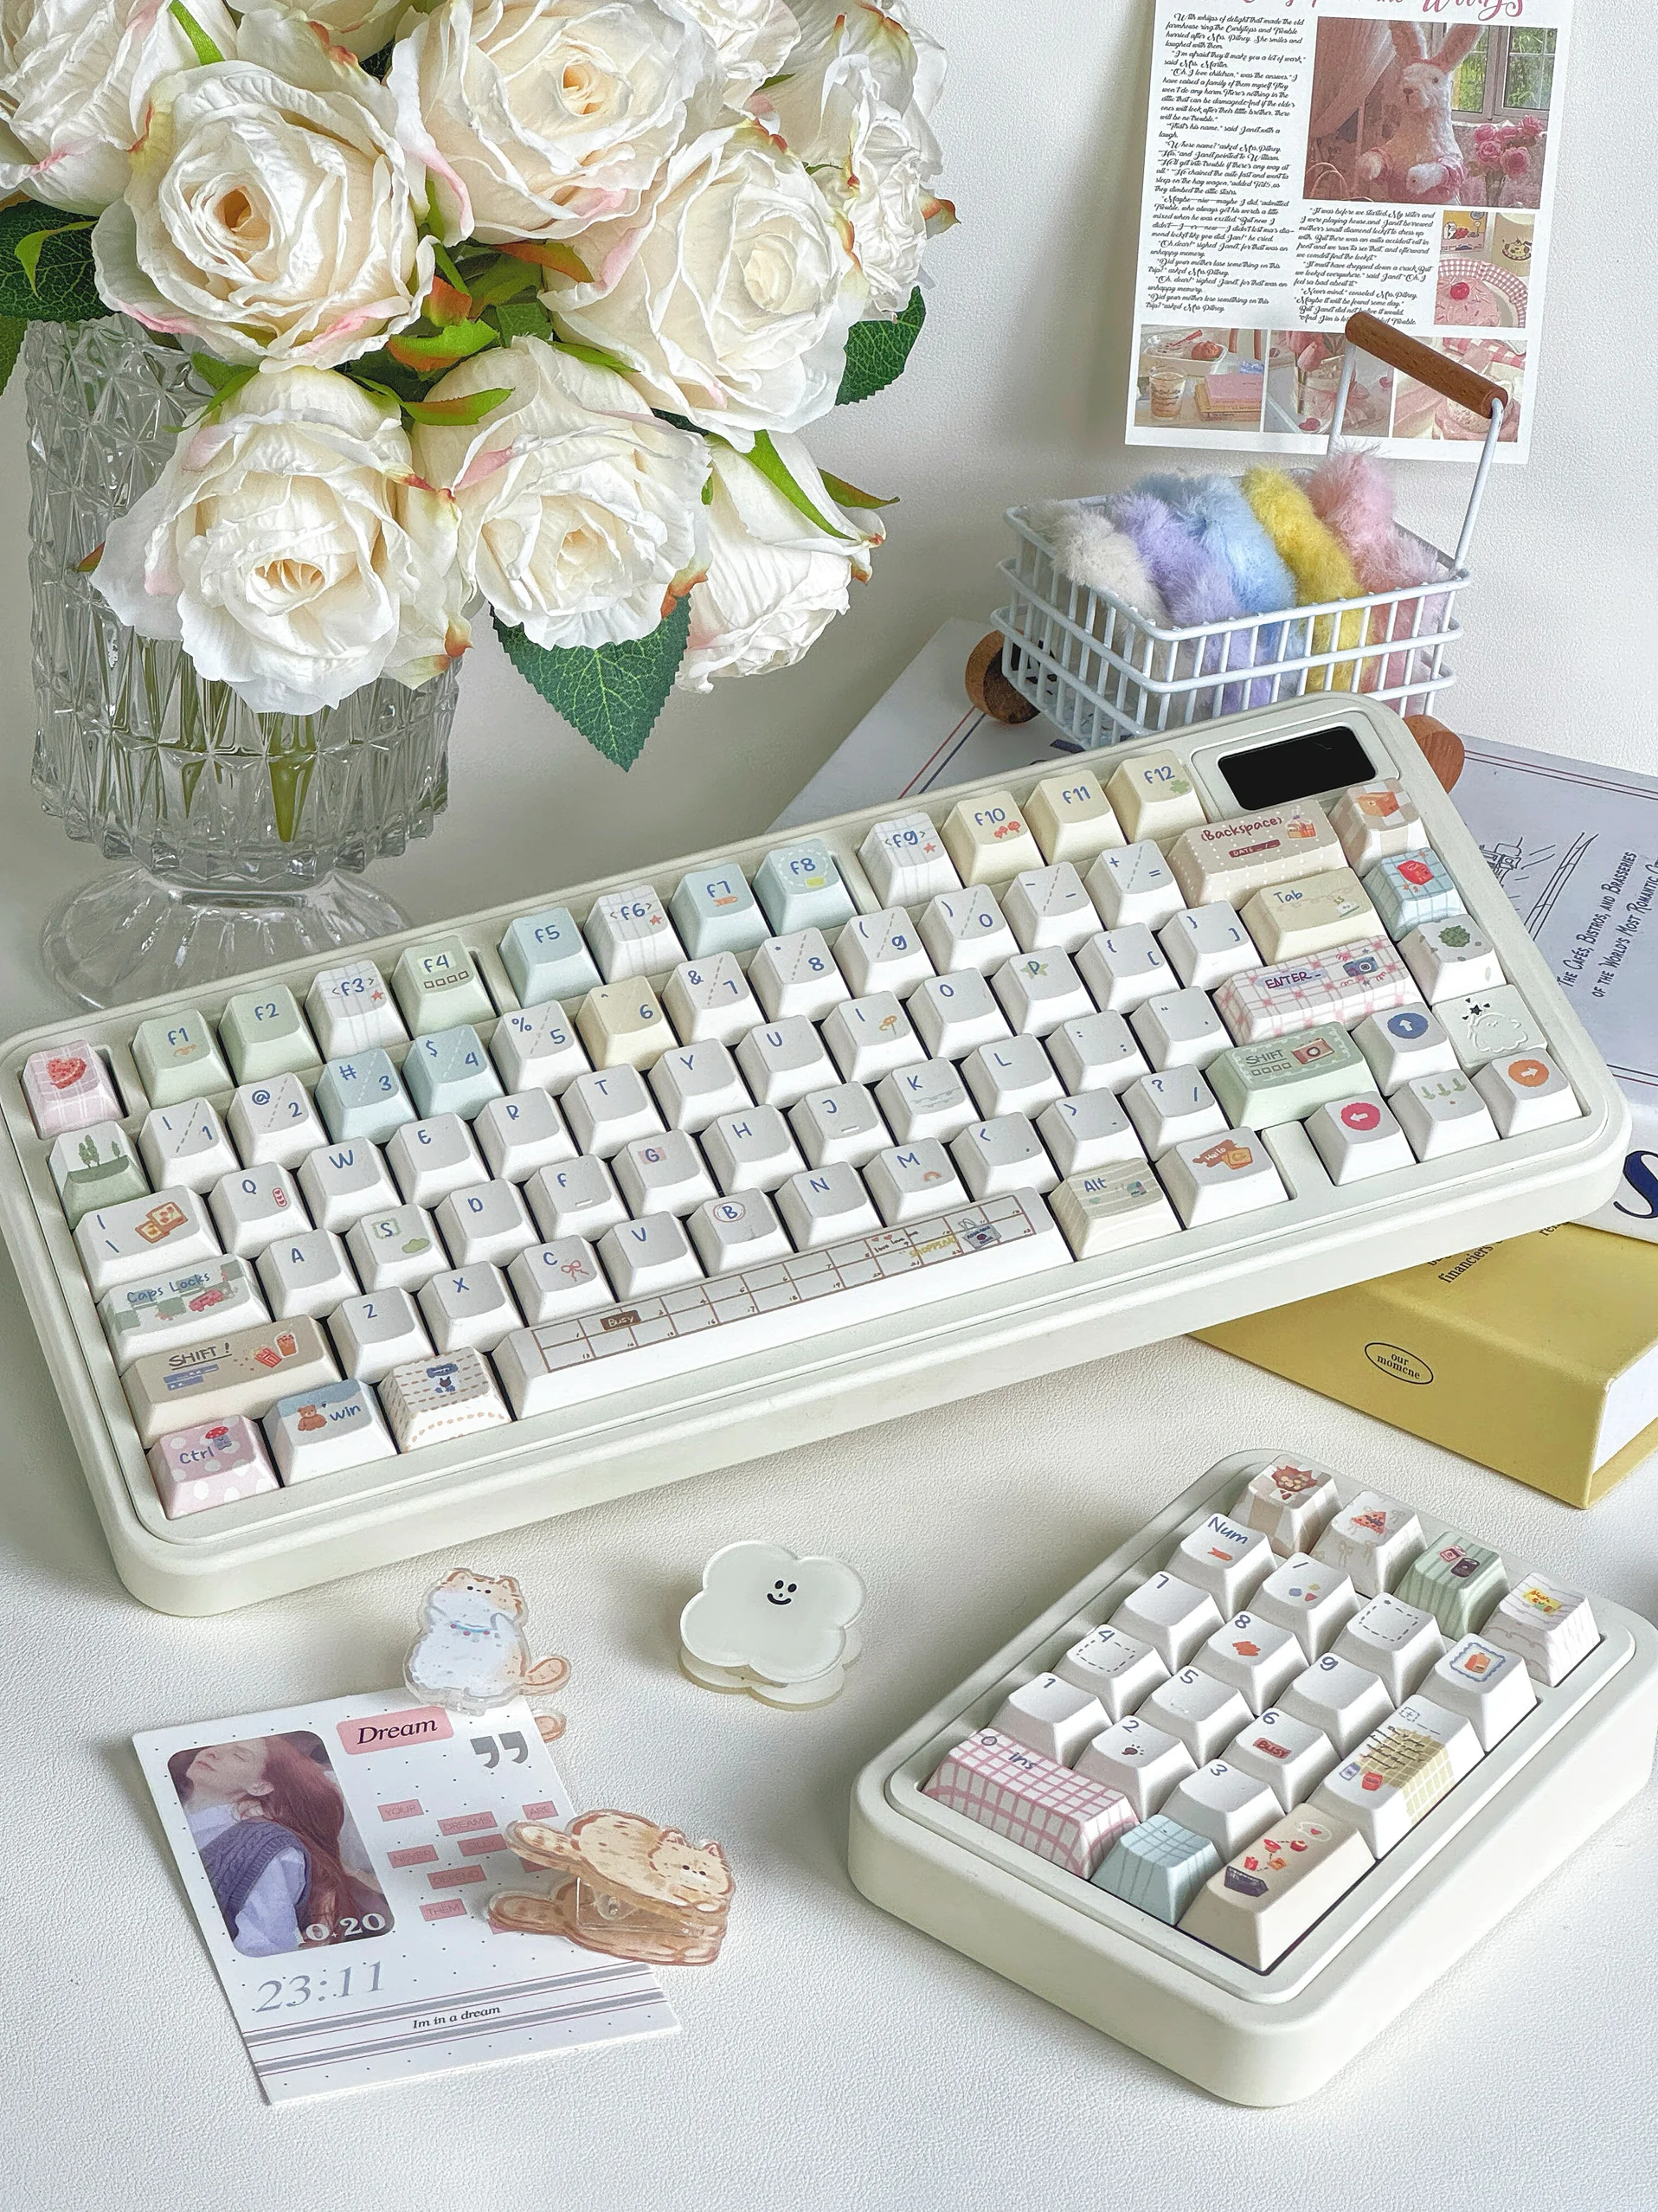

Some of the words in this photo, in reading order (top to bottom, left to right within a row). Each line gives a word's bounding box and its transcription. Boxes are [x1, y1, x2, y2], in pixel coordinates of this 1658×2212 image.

[1144, 765, 1175, 784] F12
[1062, 786, 1091, 806] F11
[974, 807, 1006, 826] F10
[790, 857, 817, 875] F8
[706, 881, 730, 898] F7
[1273, 890, 1302, 903] Tab
[535, 924, 561, 943] F5
[892, 935, 908, 950] 9
[423, 954, 451, 973] F4
[808, 957, 825, 971] 8
[1028, 961, 1041, 976] P
[723, 981, 739, 994] 7
[254, 1002, 279, 1021] F2
[639, 1004, 653, 1019] 6
[511, 1017, 532, 1032] %
[168, 1026, 189, 1045] F1
[550, 1028, 566, 1045] 5
[767, 1032, 783, 1047] U
[465, 1052, 479, 1068] 4
[681, 1055, 695, 1071] Y
[993, 1052, 1012, 1067] L
[1246, 1049, 1284, 1064] SHIFT
[339, 1064, 357, 1080] #
[379, 1075, 391, 1090] 3
[594, 1078, 610, 1096] T
[907, 1075, 923, 1091] K
[252, 1090, 270, 1106] @
[288, 1103, 302, 1118] 2
[505, 1104, 520, 1121] R
[822, 1099, 838, 1115] J
[202, 1126, 212, 1140] 1
[418, 1129, 432, 1144] E
[732, 1122, 753, 1139] H
[329, 1150, 355, 1167] W
[645, 1148, 661, 1163] G
[897, 1153, 921, 1169] M
[1205, 1148, 1227, 1161] Hello
[242, 1179, 257, 1194] Q
[556, 1173, 568, 1187] F
[810, 1177, 830, 1193] N
[1083, 1177, 1108, 1193] Alt
[469, 1199, 483, 1213] D
[723, 1206, 739, 1220] B
[380, 1222, 394, 1238] S
[632, 1226, 647, 1242] V
[291, 1248, 305, 1264] A
[543, 1251, 558, 1265] C
[1438, 1245, 1494, 1283] financiers
[127, 1286, 164, 1303] Caps
[170, 1272, 209, 1292] Locks
[453, 1277, 470, 1294] X
[607, 1315, 634, 1328] Busy
[169, 1347, 217, 1367] SHIFT
[1391, 1354, 1409, 1365] our
[179, 1446, 215, 1464] Ctrl
[1207, 1516, 1249, 1545] Num
[1157, 1574, 1169, 1589] 7
[1235, 1614, 1250, 1629] 8
[1098, 1630, 1115, 1643] 4
[1320, 1656, 1339, 1671] 9
[1044, 1678, 1056, 1688] 1
[1179, 1669, 1199, 1684] 5
[1263, 1712, 1280, 1724] 6
[357, 1720, 437, 1745] Dream
[1122, 1720, 1139, 1733] 2
[1256, 1739, 1288, 1758] BUSY
[1210, 1765, 1228, 1777] 3
[529, 1806, 551, 1815] ARE
[427, 1904, 460, 1915] THEM
[253, 1960, 384, 2013] 23:11
[413, 2018, 431, 2029] Im
[434, 2016, 446, 2025] in
[449, 2014, 458, 2022] a
[460, 2005, 501, 2021] dream
